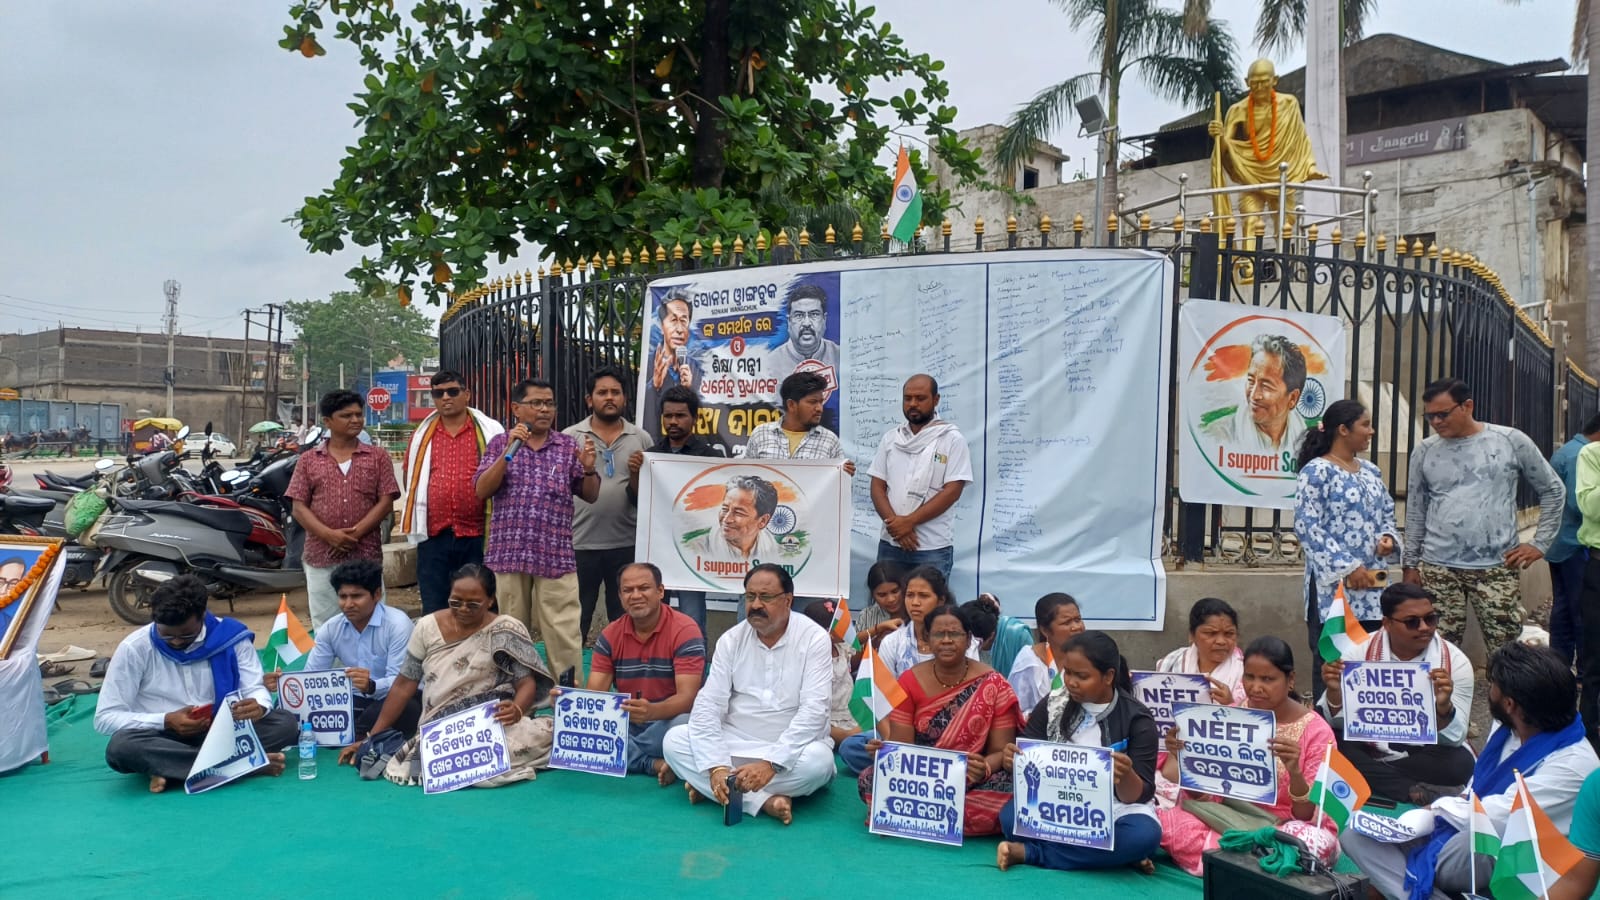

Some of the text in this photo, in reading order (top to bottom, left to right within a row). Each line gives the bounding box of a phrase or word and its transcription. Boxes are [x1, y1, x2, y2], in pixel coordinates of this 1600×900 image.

[693, 289, 730, 308] ସୋନମ
[718, 315, 753, 336] ସମର୍ଥନ
[756, 317, 772, 332] ରେ
[712, 354, 733, 373] ଶିକ୍ଷା
[368, 394, 389, 404] STOP
[1218, 445, 1224, 467] I
[1227, 452, 1279, 474] support
[696, 556, 701, 571] I
[704, 560, 750, 575] support
[304, 677, 329, 690] ପେପର
[1366, 668, 1416, 688] NEET
[325, 692, 349, 706] ଭାରତ
[1143, 687, 1200, 704] NEET
[1357, 690, 1398, 706] ପେପର
[311, 714, 345, 729] ଦରକାର
[603, 719, 618, 736] ସହ
[1188, 718, 1259, 744] NEET
[476, 728, 493, 743] ସହ
[1051, 748, 1088, 765] ସୋନମ
[1184, 740, 1232, 759] ପେପର
[900, 752, 953, 780] NEET
[889, 777, 929, 798] ପେପର
[1057, 790, 1083, 803] ଆମର
[1038, 801, 1106, 829] ସମର୍ଥନ
